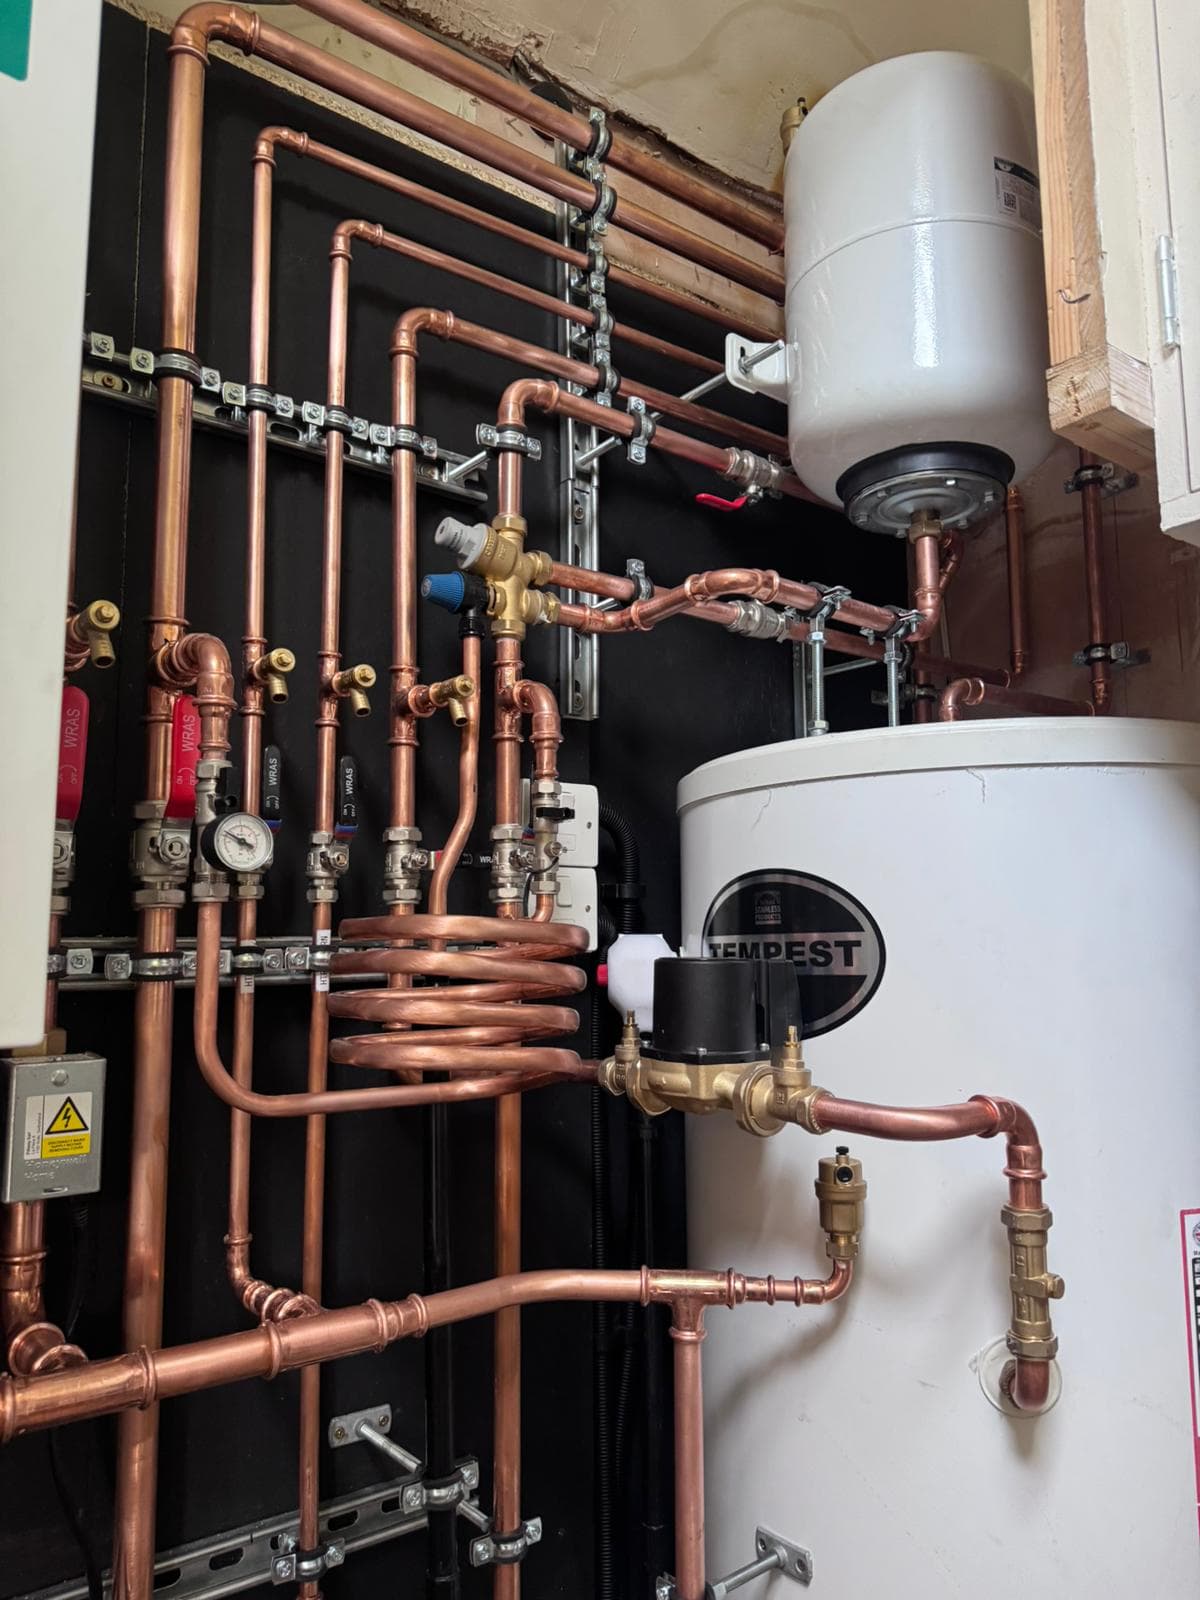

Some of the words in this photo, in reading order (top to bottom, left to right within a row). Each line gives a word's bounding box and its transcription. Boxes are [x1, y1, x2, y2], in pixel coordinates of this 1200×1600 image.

[64, 708, 80, 748] WRAS
[182, 714, 195, 752] WRAS
[268, 757, 278, 786] WRAS
[345, 767, 354, 795] WRAS
[708, 940, 862, 968] TEMPEST
